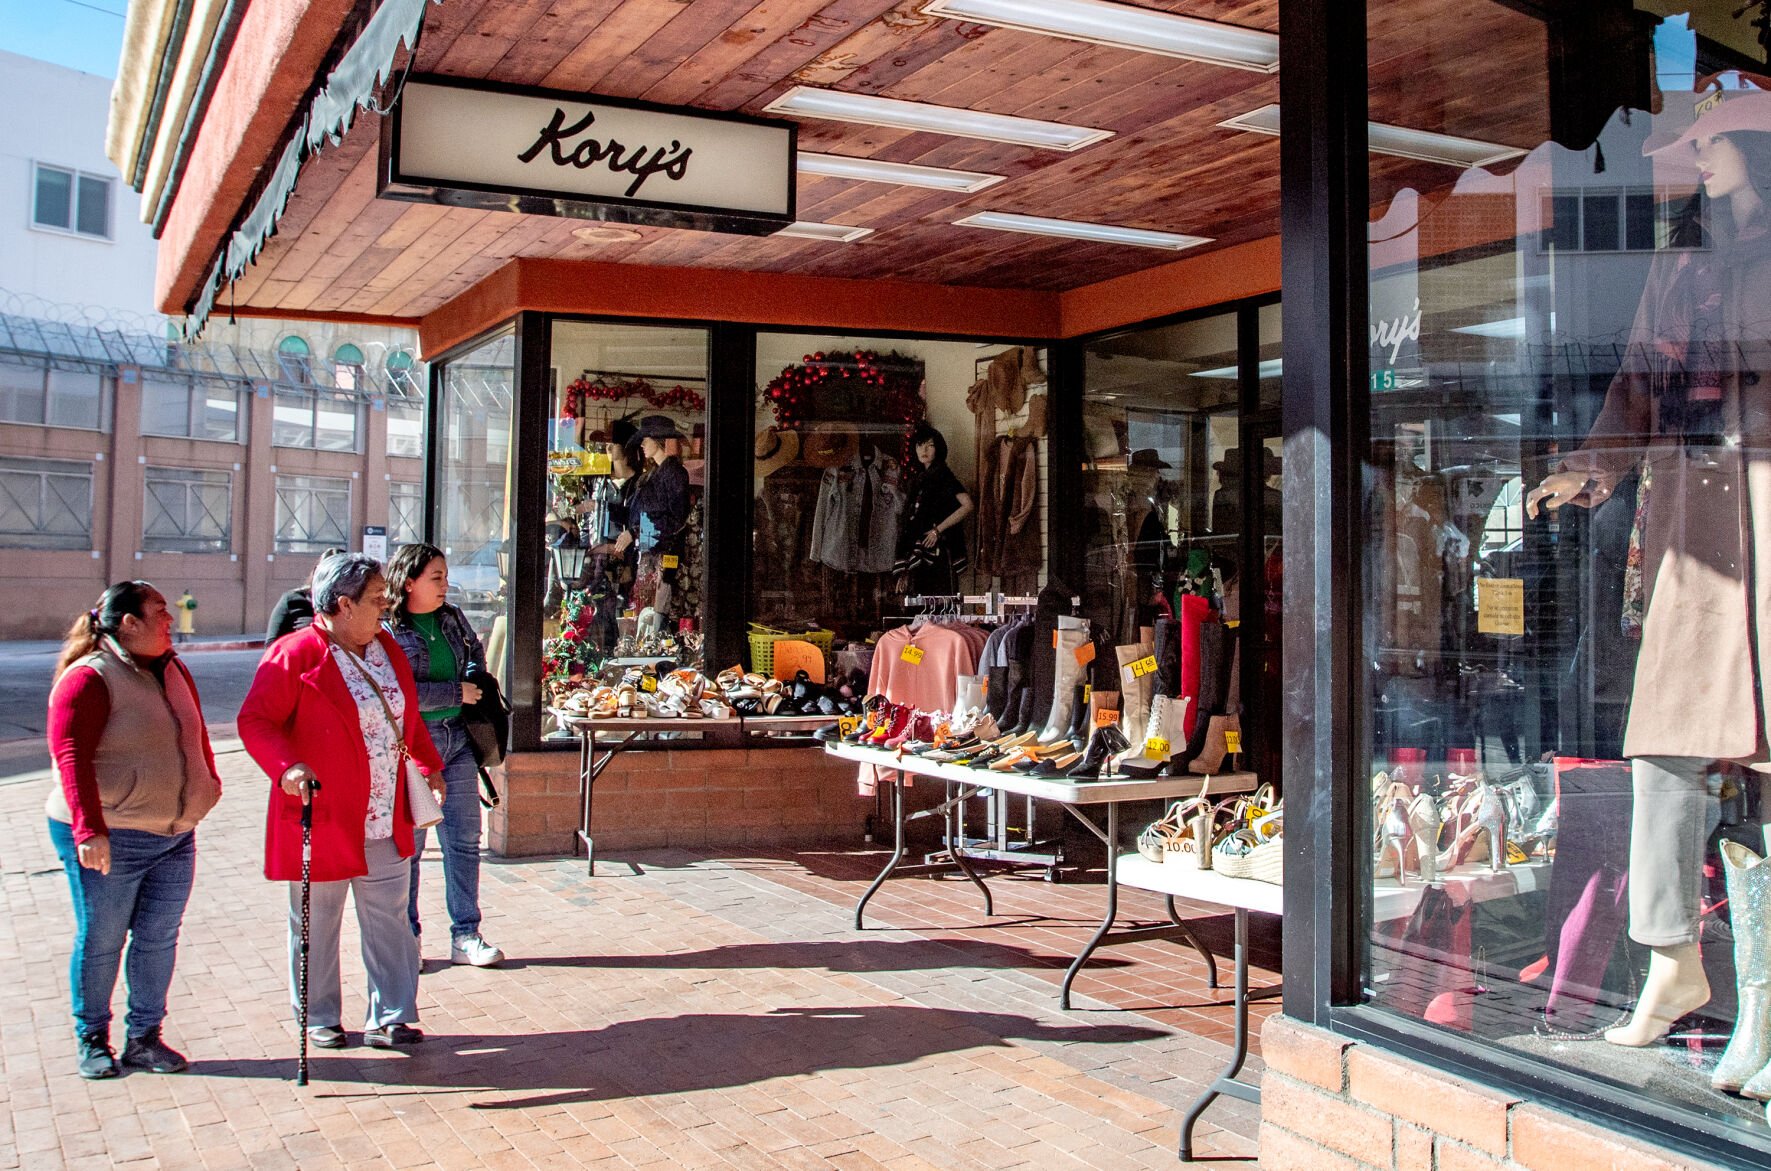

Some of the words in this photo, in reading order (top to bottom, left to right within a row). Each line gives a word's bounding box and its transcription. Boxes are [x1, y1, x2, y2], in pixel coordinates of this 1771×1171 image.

[518, 107, 694, 198] Kory's
[904, 647, 923, 659] 14.99
[1098, 711, 1118, 722] 15.99
[1148, 740, 1170, 753] 12.00
